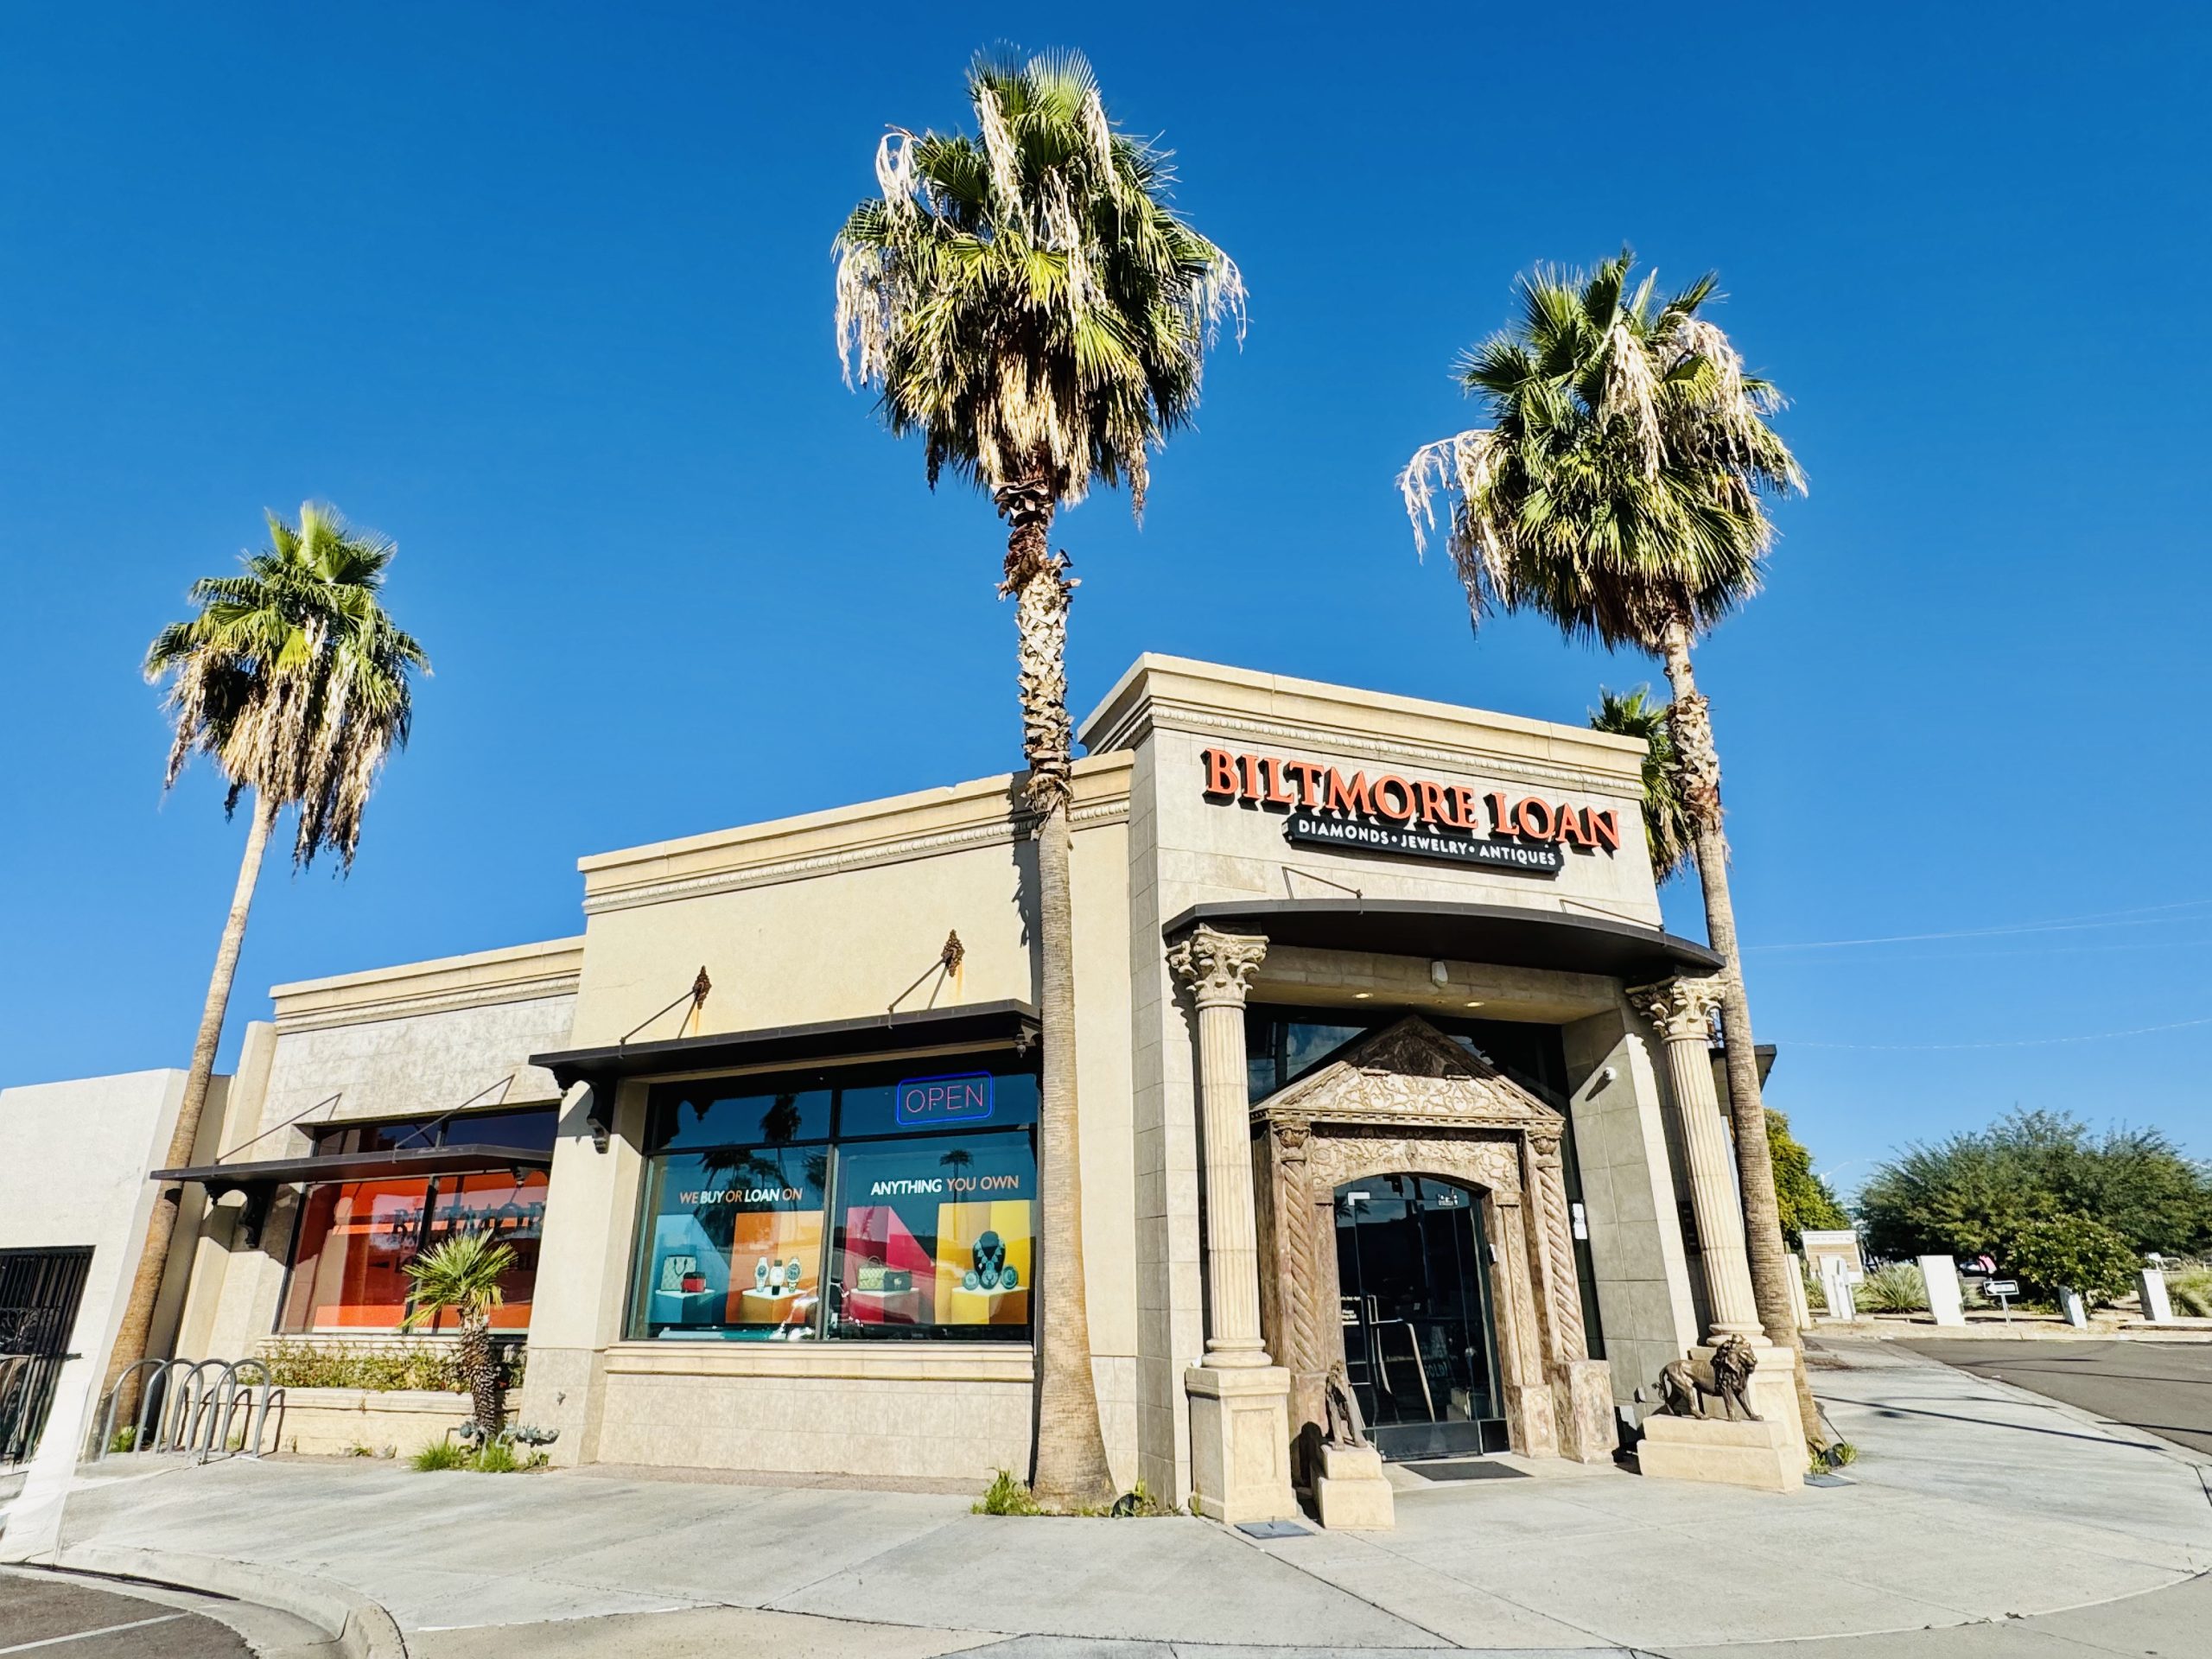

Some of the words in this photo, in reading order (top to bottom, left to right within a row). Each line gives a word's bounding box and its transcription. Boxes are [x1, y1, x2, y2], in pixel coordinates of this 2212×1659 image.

[1206, 748, 1478, 829] BILTMORE
[1491, 792, 1618, 849] LOAN
[1299, 819, 1389, 844] DIAMONDS
[1401, 834, 1467, 855] JEWELRY
[1479, 844, 1555, 865] ANTIQUES
[906, 1083, 983, 1113] OPEN
[680, 1192, 698, 1204] WE
[700, 1190, 725, 1204] BUY
[726, 1190, 743, 1203] OR
[745, 1188, 779, 1202] LOAN
[782, 1187, 803, 1200] ON
[871, 1179, 943, 1196] ANYTHING
[946, 1177, 976, 1192] YOU
[980, 1175, 1019, 1191] OWN
